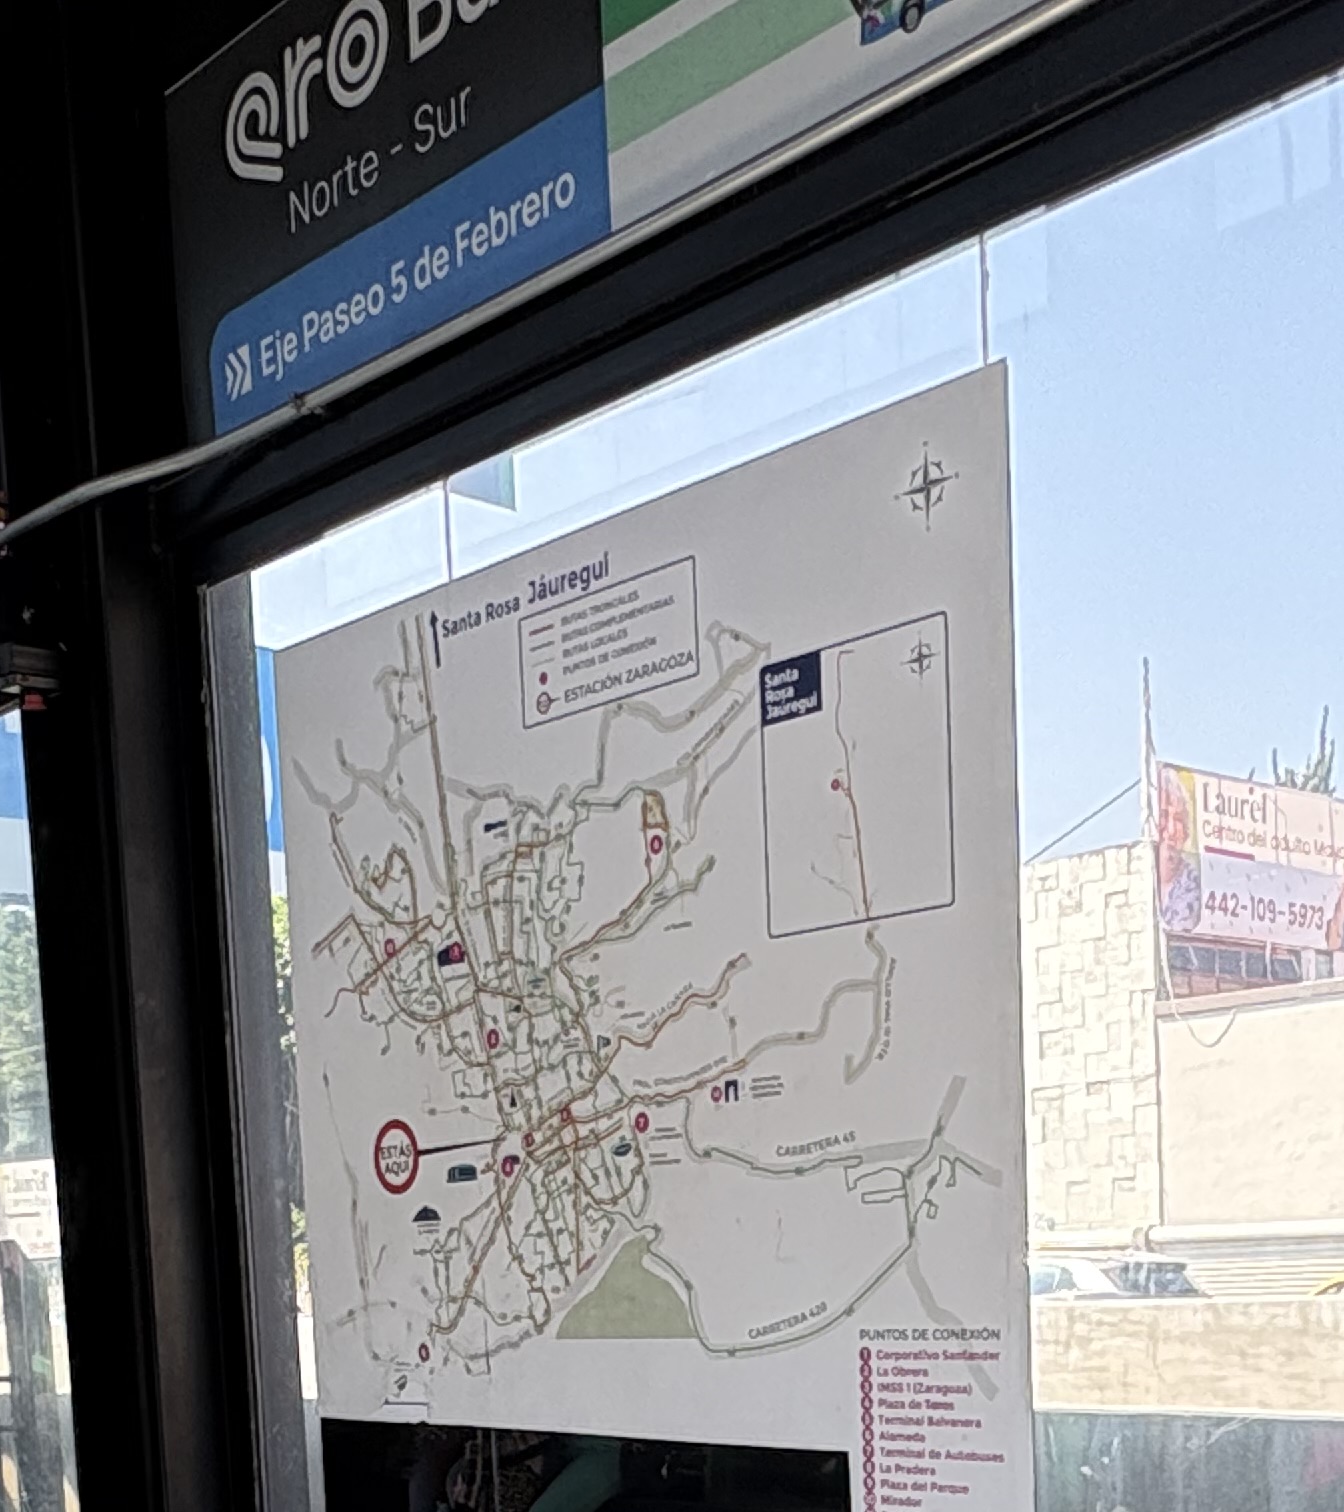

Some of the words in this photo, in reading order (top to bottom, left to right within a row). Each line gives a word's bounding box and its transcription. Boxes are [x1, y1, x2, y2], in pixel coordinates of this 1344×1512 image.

[289, 150, 380, 234] Norte
[414, 87, 471, 154] Sur
[261, 331, 298, 381] Eje
[303, 284, 385, 352] Paseo
[392, 260, 407, 303] 5
[414, 245, 450, 290] de
[456, 173, 575, 267] Febrero
[442, 610, 481, 638] Santa
[485, 596, 520, 621] Rosa
[1203, 783, 1267, 824] Laurel
[1205, 891, 1325, 930] 442-109-5973
[381, 1142, 411, 1160] ESTÁS
[859, 1329, 909, 1341] PUNTOS
[912, 1329, 929, 1340] DE
